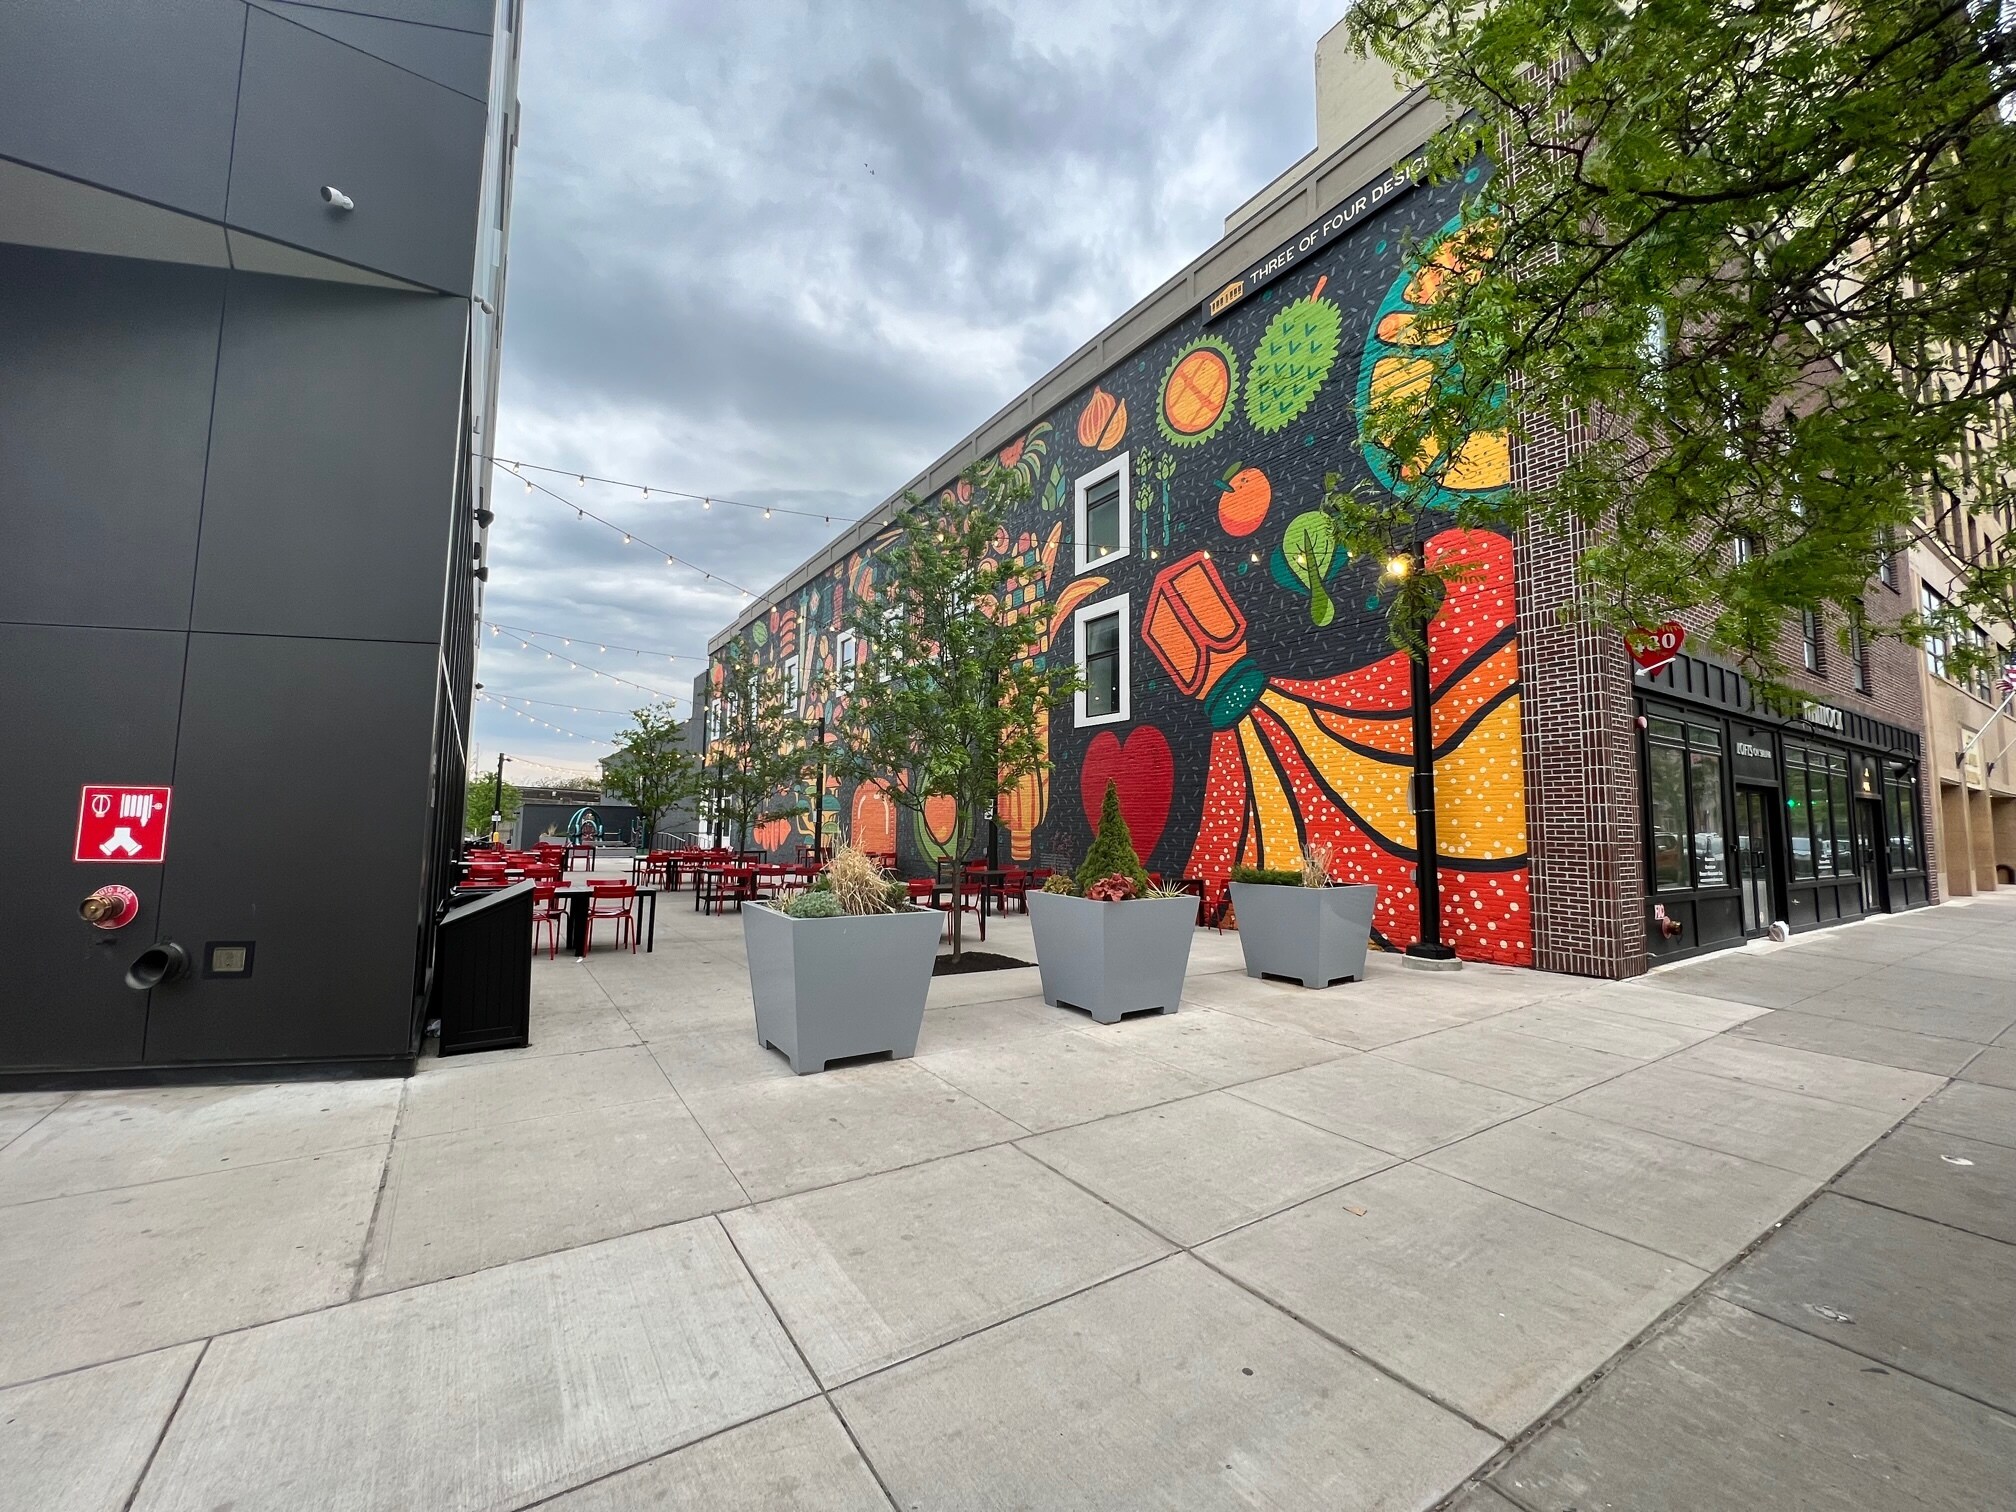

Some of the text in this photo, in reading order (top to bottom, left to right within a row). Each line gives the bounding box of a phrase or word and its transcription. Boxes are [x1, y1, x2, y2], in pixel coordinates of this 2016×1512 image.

[1249, 246, 1295, 284] THREE
[1298, 229, 1320, 252] OF
[1323, 197, 1367, 237] FOUR
